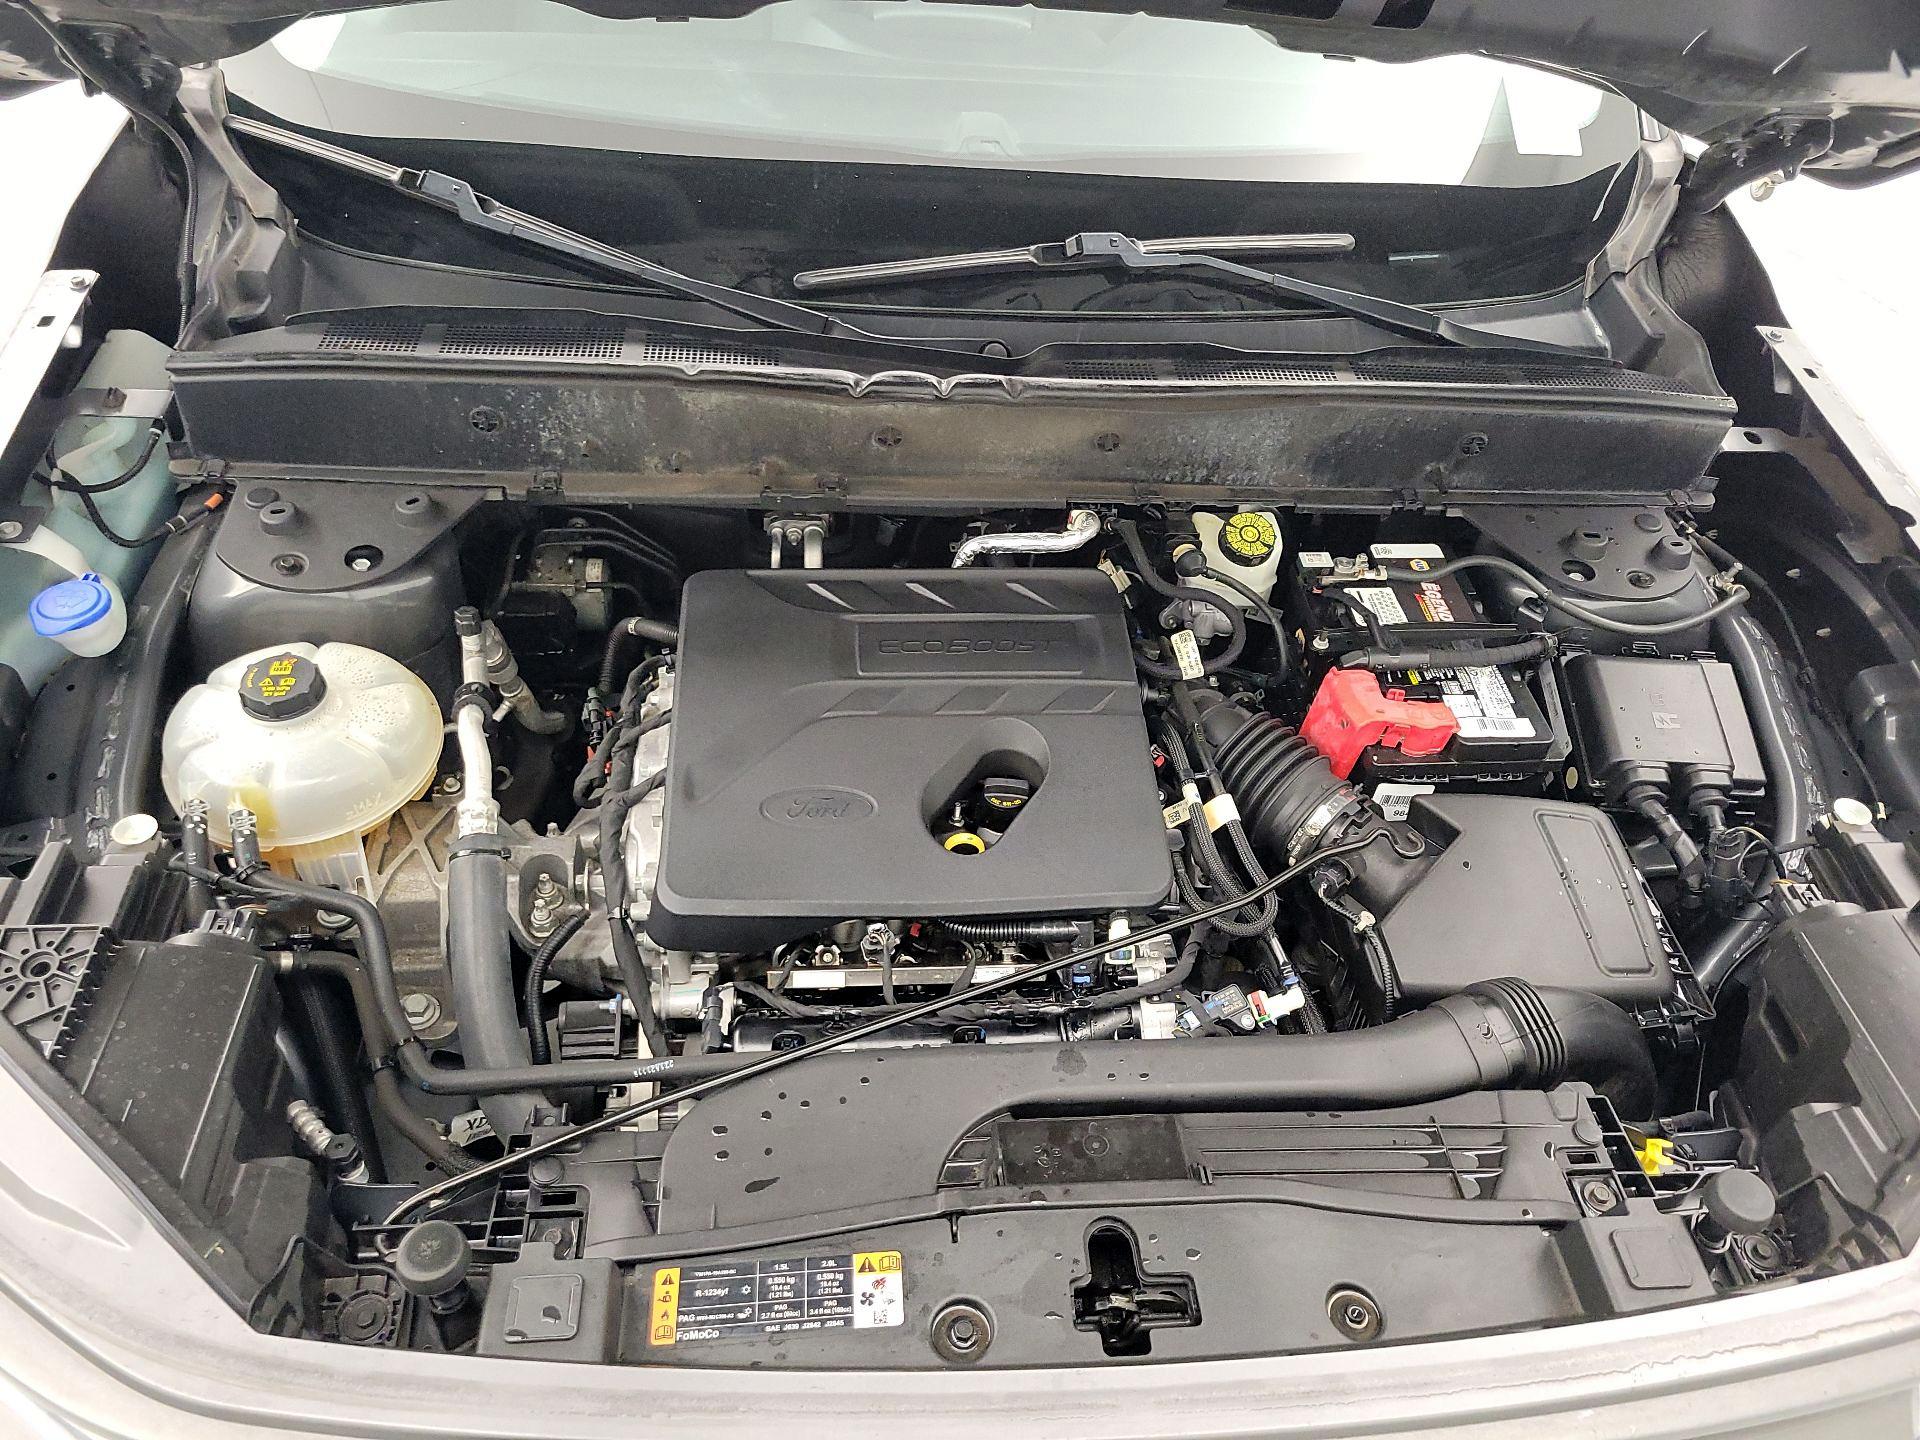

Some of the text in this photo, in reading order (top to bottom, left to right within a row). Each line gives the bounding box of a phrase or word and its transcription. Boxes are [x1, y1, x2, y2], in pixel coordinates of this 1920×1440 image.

[1420, 581, 1455, 622] EGEND
[786, 796, 851, 818] Ford
[774, 1259, 837, 1271] 1.5L 2.0L
[787, 1275, 796, 1285] kg
[836, 1271, 844, 1281] kg
[695, 1287, 729, 1298] R-1234yf
[824, 1299, 838, 1307] PAG
[678, 1313, 696, 1322] PAG
[765, 1324, 781, 1332] SAE
[677, 1329, 720, 1341] FoMoCo
